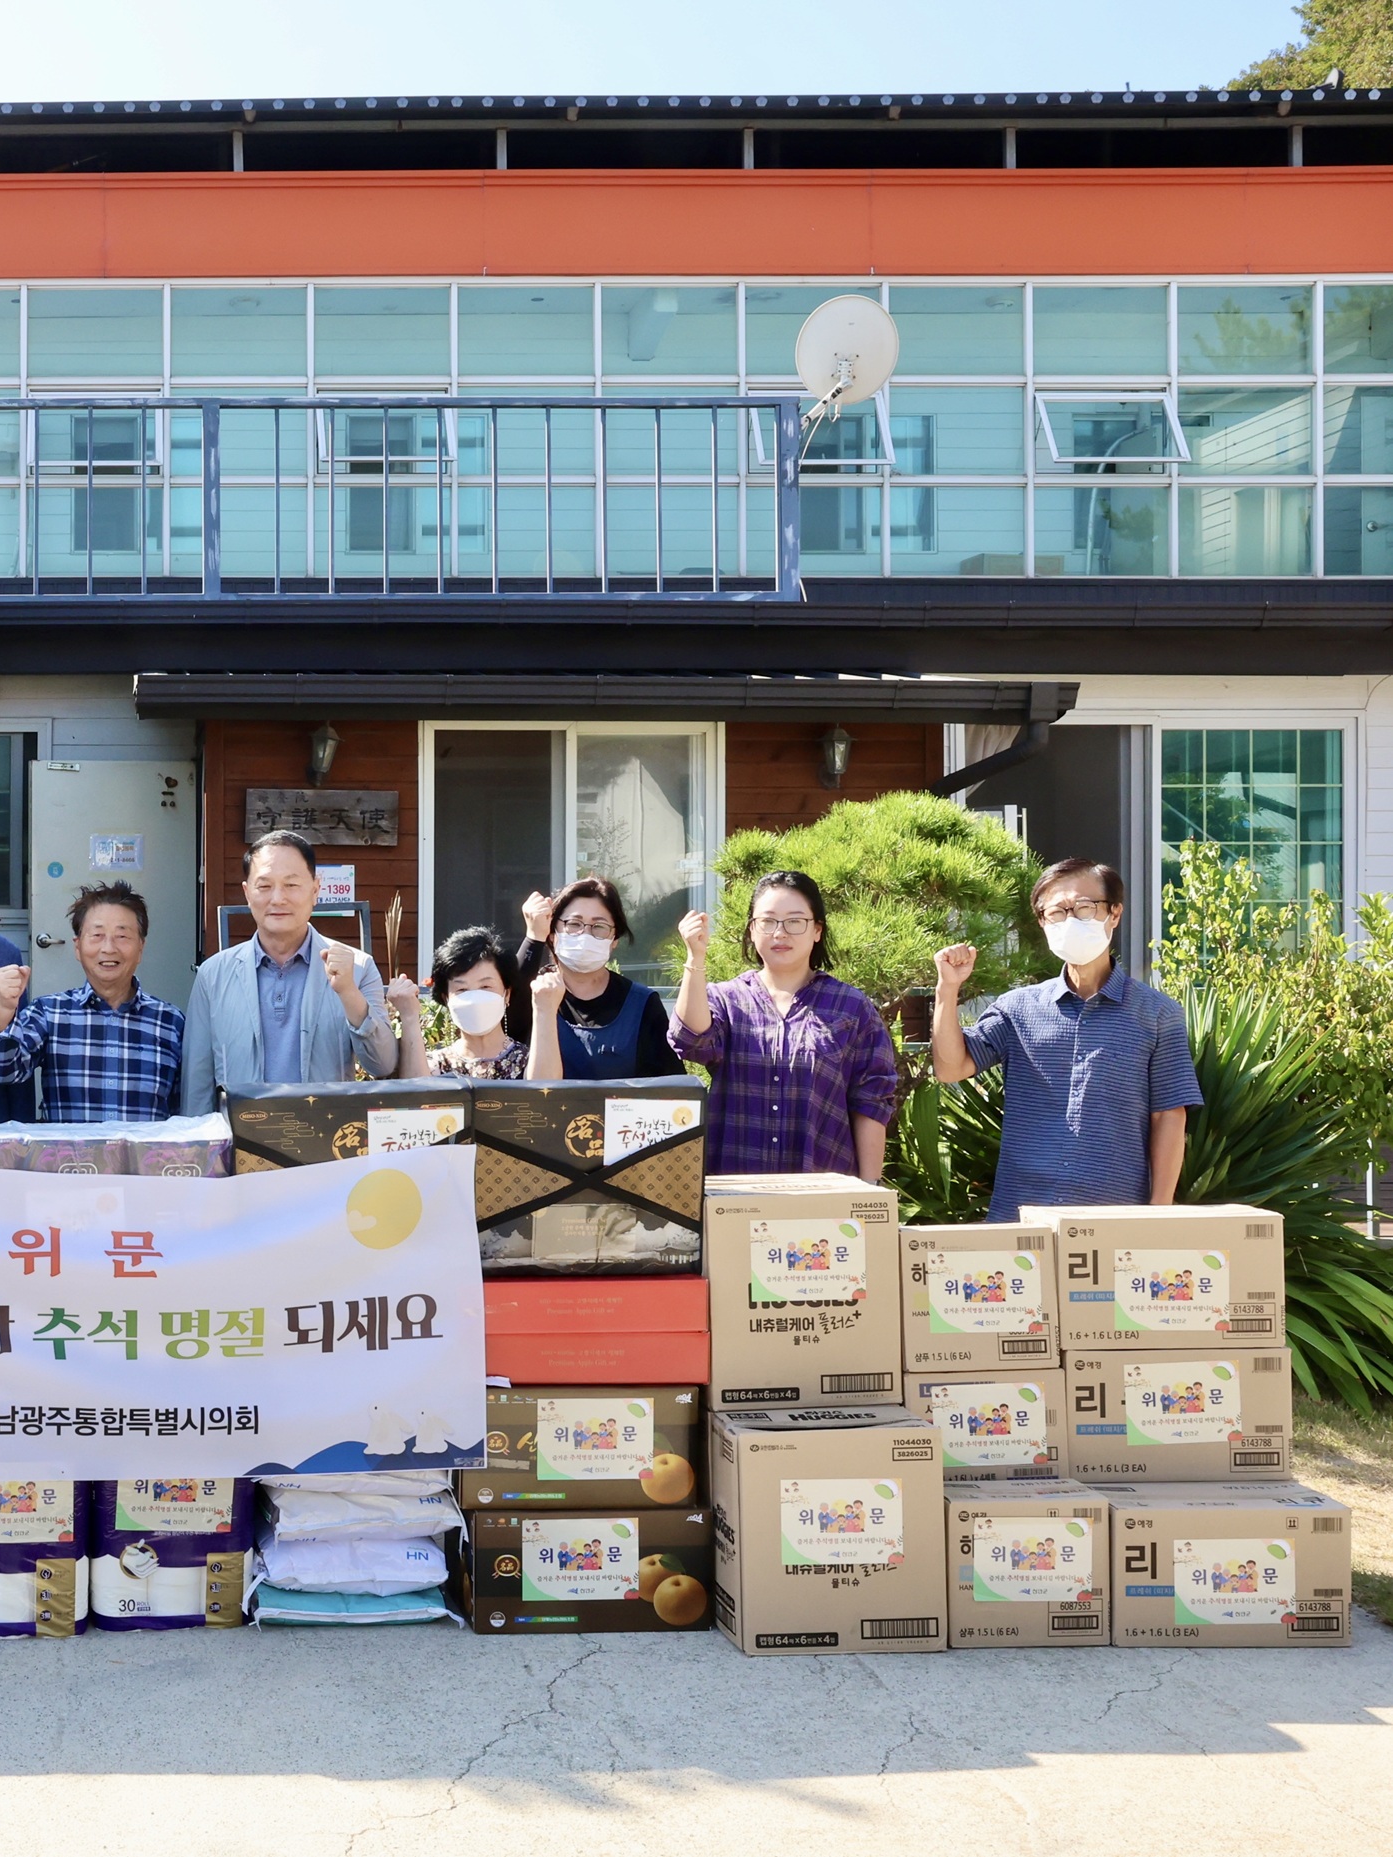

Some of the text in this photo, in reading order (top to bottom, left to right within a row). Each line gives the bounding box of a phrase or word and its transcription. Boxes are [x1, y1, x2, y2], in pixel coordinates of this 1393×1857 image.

[319, 885, 350, 895] -1389
[1068, 1250, 1098, 1285] 리
[945, 1279, 1025, 1295] 위 문
[1130, 1278, 1213, 1293] 위 문
[1233, 1305, 1264, 1314] 6143788
[33, 1308, 139, 1360] 추석
[159, 1307, 265, 1359] 명절
[284, 1294, 443, 1353] 되세요
[749, 1318, 815, 1332] 내츄럴케어
[793, 1335, 820, 1345] 물티슈
[1069, 1332, 1082, 1340] 1.6
[1092, 1331, 1105, 1340] 1.6
[1114, 1331, 1122, 1340] (3
[1125, 1330, 1139, 1340] EA)
[915, 1353, 929, 1362] 샴푸
[932, 1353, 943, 1361] 1.5
[950, 1352, 957, 1361] (6
[959, 1352, 971, 1361] EA)
[1087, 1361, 1102, 1369] 애경
[1075, 1383, 1106, 1418] 리
[1142, 1389, 1224, 1408] 위 문
[949, 1411, 1030, 1429] 위 문
[1241, 1438, 1272, 1447] 6143788
[1076, 1465, 1089, 1473] 1.6
[1099, 1464, 1112, 1473] 1.6
[1121, 1464, 1129, 1473] (3
[1132, 1463, 1146, 1473] EA)
[1137, 1520, 1153, 1528] 애경
[991, 1546, 1075, 1562] 위 문
[1125, 1542, 1157, 1579] 리
[1192, 1568, 1278, 1585] 위 문
[831, 1578, 860, 1589] 물티슈
[1060, 1602, 1091, 1610] 6087553
[1299, 1603, 1331, 1612] 6143788
[959, 1628, 974, 1637] 샴푸
[977, 1628, 989, 1636] 1.5
[997, 1627, 1004, 1637] (6
[1006, 1627, 1019, 1636] EA)
[1125, 1628, 1138, 1637] 1.6
[1149, 1628, 1162, 1637] 1.6
[1172, 1627, 1181, 1638] (3
[1184, 1627, 1199, 1637] EA)
